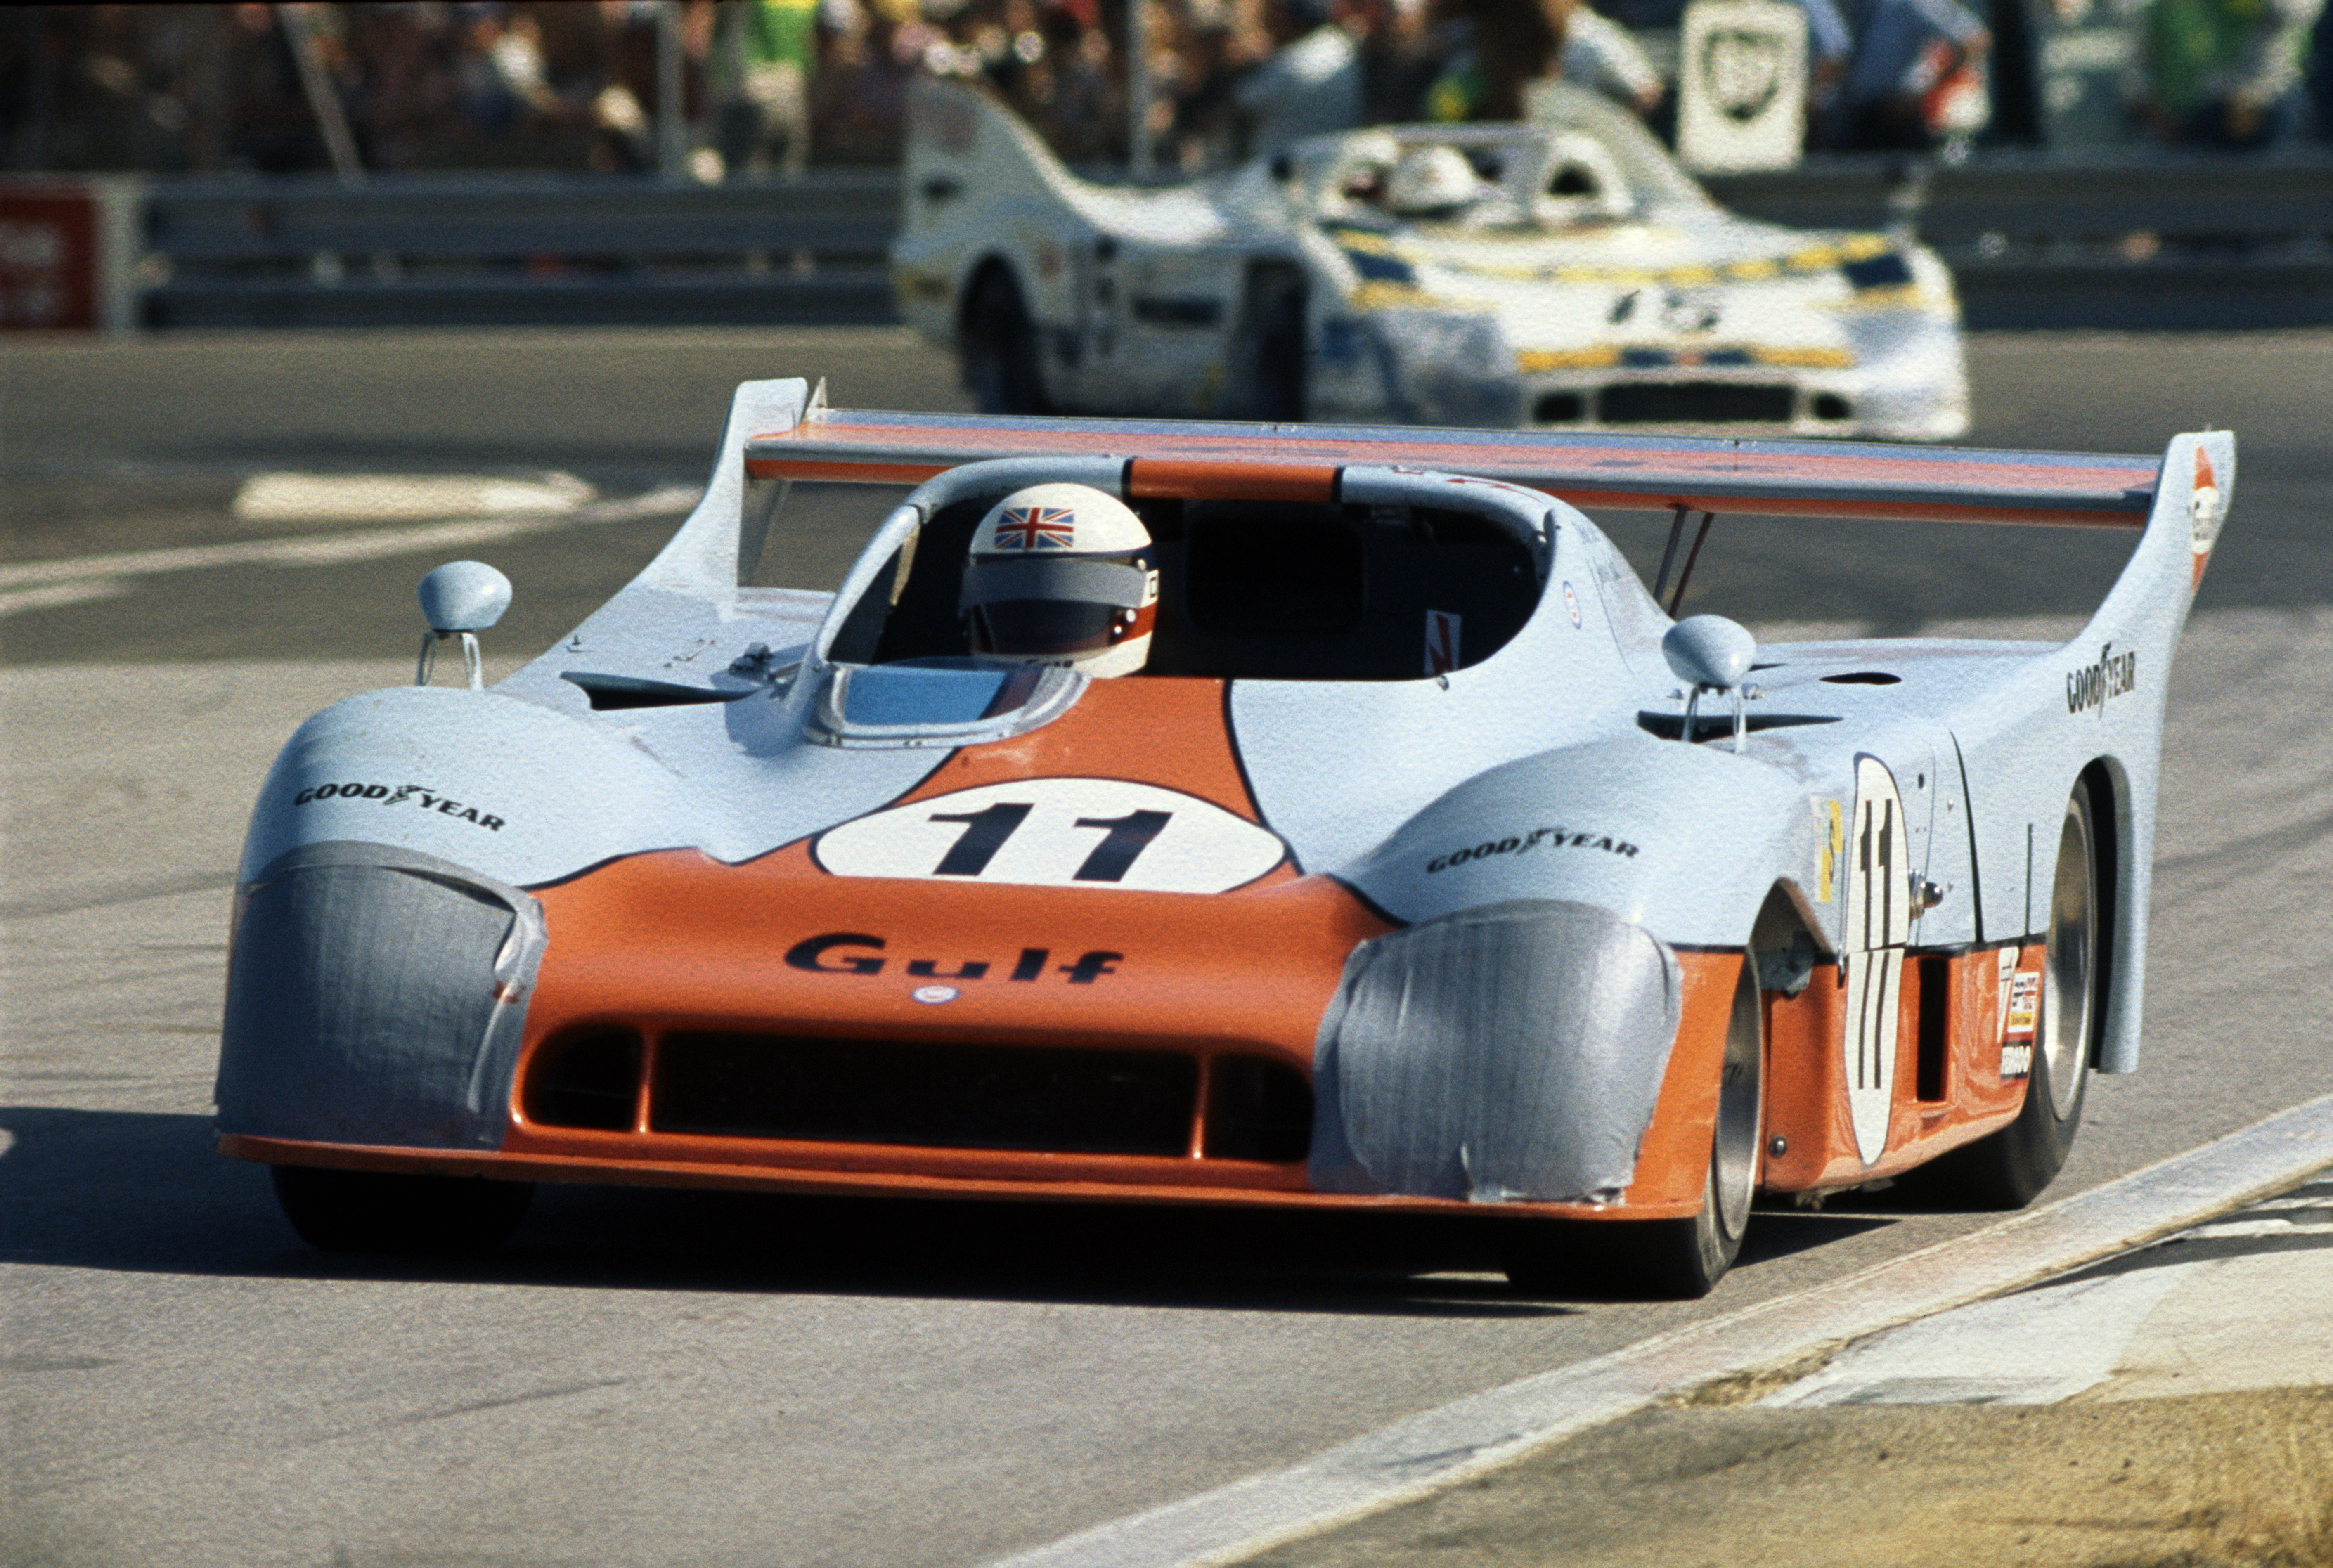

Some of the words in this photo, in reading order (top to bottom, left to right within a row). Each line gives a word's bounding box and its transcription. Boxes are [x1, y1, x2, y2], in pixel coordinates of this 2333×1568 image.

[927, 802, 1174, 882] 11
[784, 932, 1124, 984] Gulf
[1858, 798, 1893, 1090] 11
